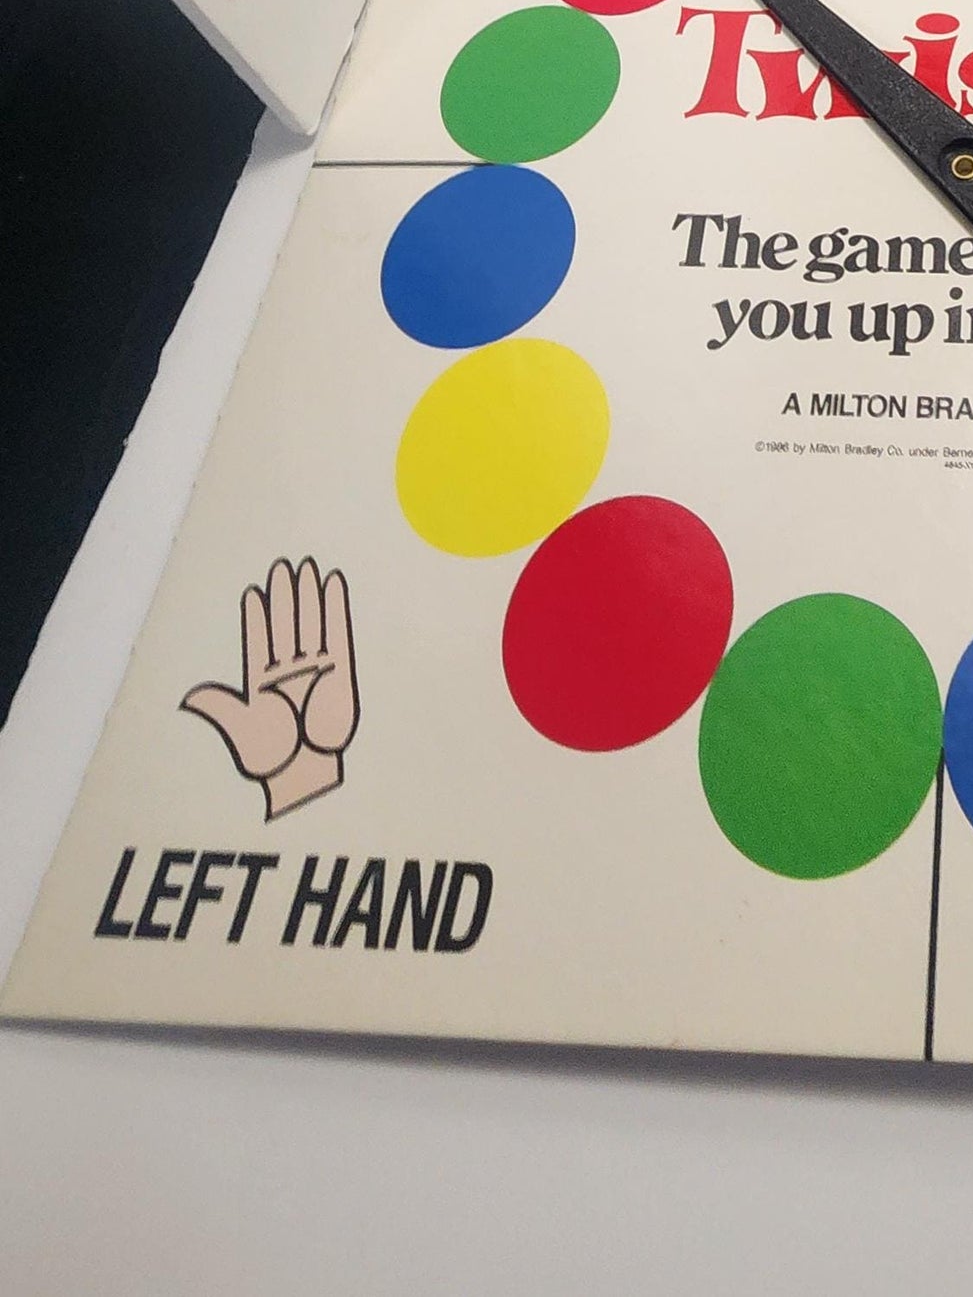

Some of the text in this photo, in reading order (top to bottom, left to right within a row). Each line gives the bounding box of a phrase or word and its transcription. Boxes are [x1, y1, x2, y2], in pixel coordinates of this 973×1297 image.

[671, 212, 798, 271] The
[706, 297, 836, 351] you
[848, 300, 935, 357] up
[781, 392, 802, 416] A
[809, 392, 908, 419] MILTON
[793, 442, 806, 455] by
[809, 442, 840, 454] Milton
[844, 443, 884, 458] Bradley
[908, 445, 938, 457] under
[942, 446, 973, 458] Berne
[94, 847, 494, 954] LEFT HAND
